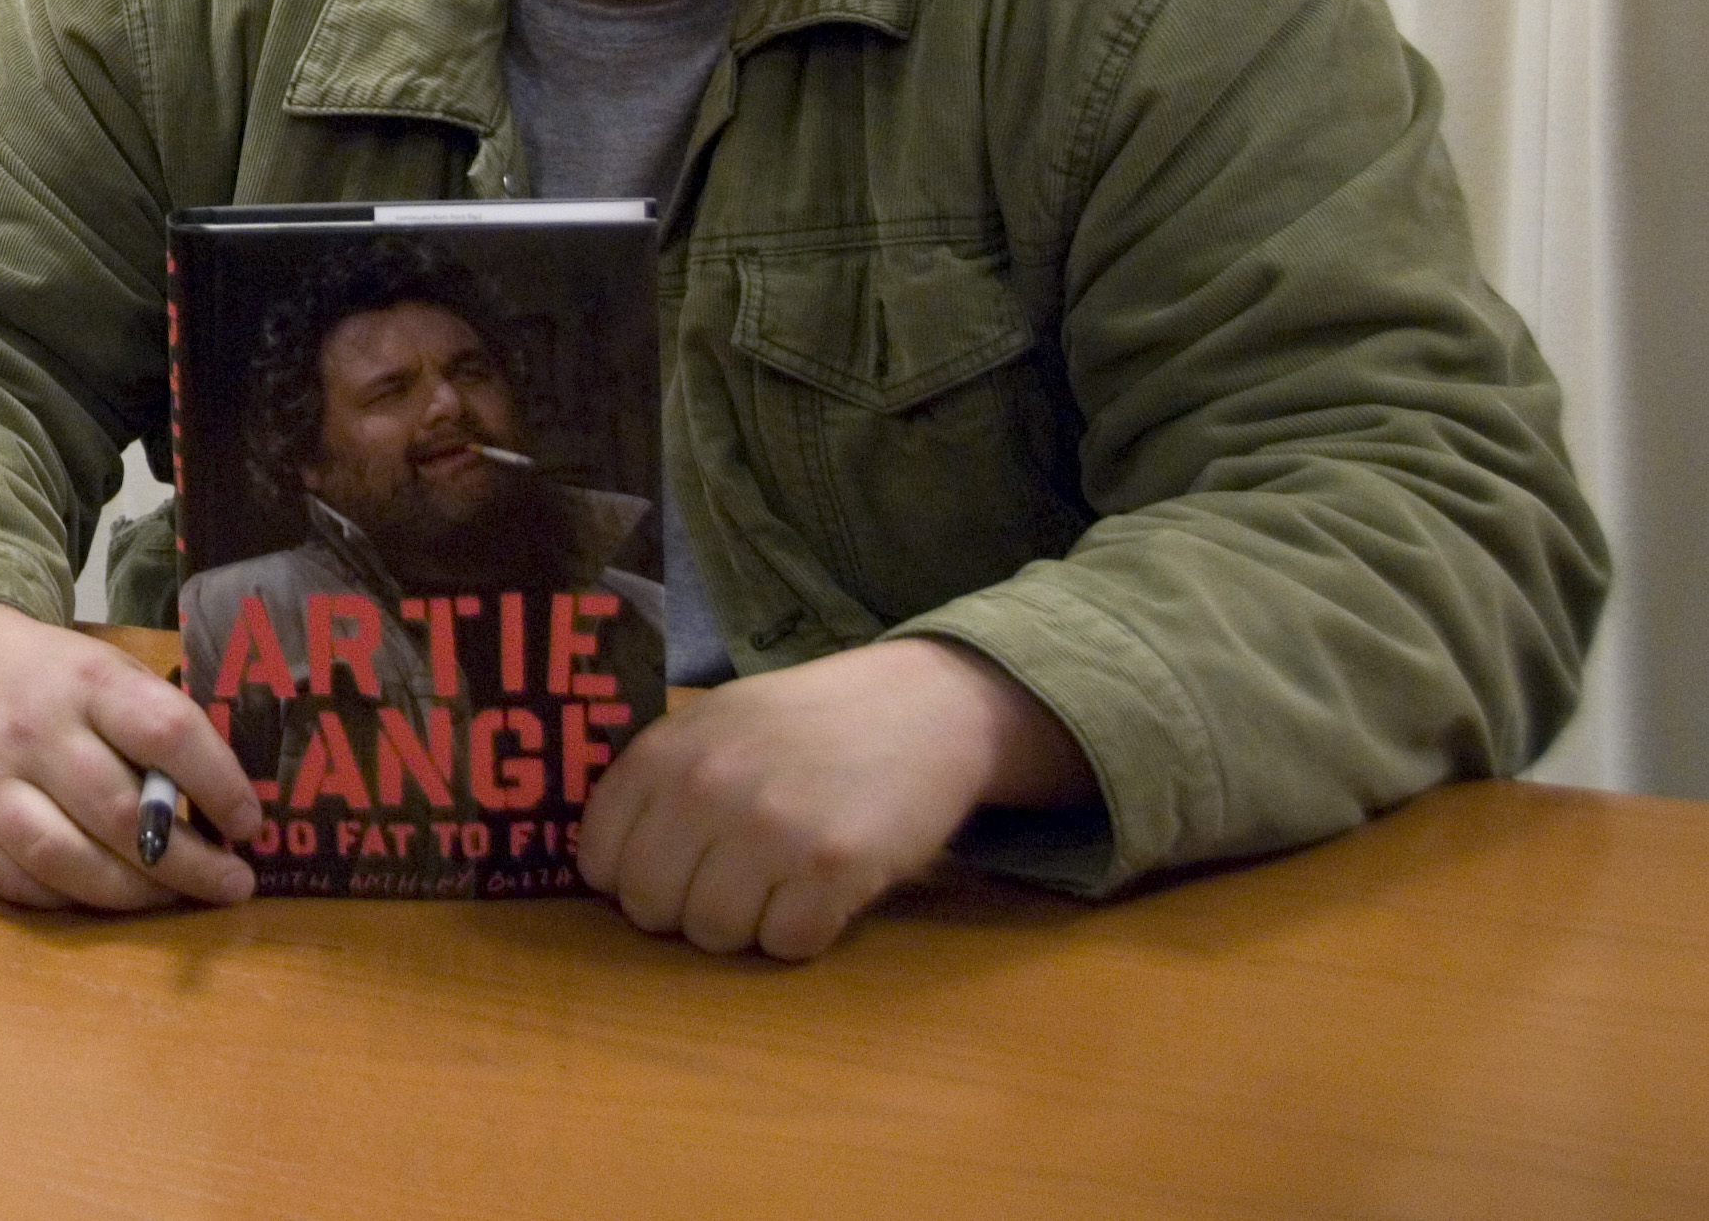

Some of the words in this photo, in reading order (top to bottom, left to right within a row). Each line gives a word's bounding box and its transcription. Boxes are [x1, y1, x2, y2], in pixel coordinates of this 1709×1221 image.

[214, 593, 619, 698] ARTIE
[225, 819, 318, 856] OO
[336, 820, 415, 858] FAT
[431, 821, 490, 858] TO
[508, 820, 582, 858] FIS
